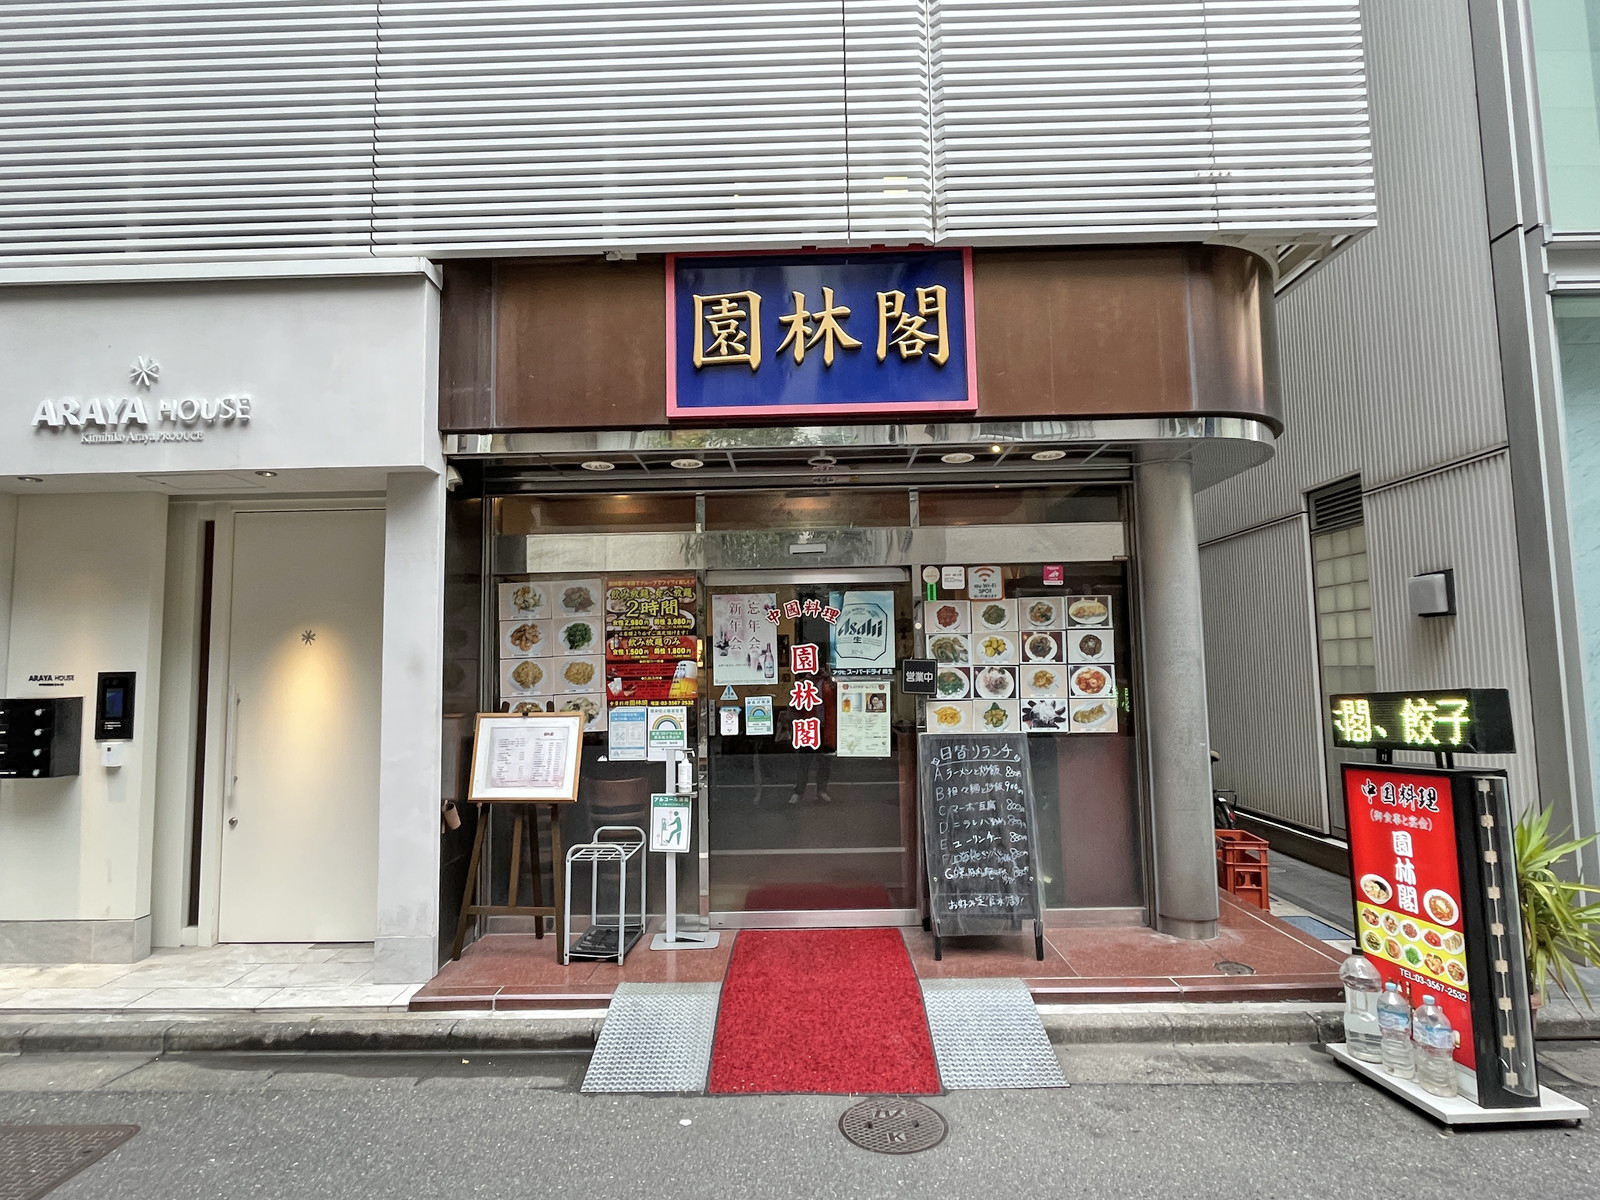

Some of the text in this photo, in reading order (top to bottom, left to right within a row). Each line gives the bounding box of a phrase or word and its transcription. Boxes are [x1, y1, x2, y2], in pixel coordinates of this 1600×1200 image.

[693, 284, 950, 371] 園林閣
[32, 395, 253, 426] ARAYA HOUSE
[626, 600, 678, 617] 2時間
[767, 600, 841, 625] 中國料理
[729, 602, 742, 650] 新年会
[748, 601, 761, 650] 忘年会
[838, 618, 883, 638] Asahi
[628, 636, 680, 646] 飲み放題のみ
[853, 636, 862, 644] 生
[905, 671, 934, 683] 営業中
[789, 644, 823, 749] 園林閣
[1332, 698, 1470, 745] 閣、餃子
[940, 743, 1013, 760] 日替りランチ
[934, 767, 943, 782] A
[935, 786, 945, 801] B
[1361, 778, 1440, 813] 中国料理
[938, 805, 946, 816] C
[940, 821, 949, 834] D
[940, 839, 948, 850] E
[1392, 831, 1419, 914] 園林閣
[1399, 967, 1467, 1002] TEL:03-3567-2532
